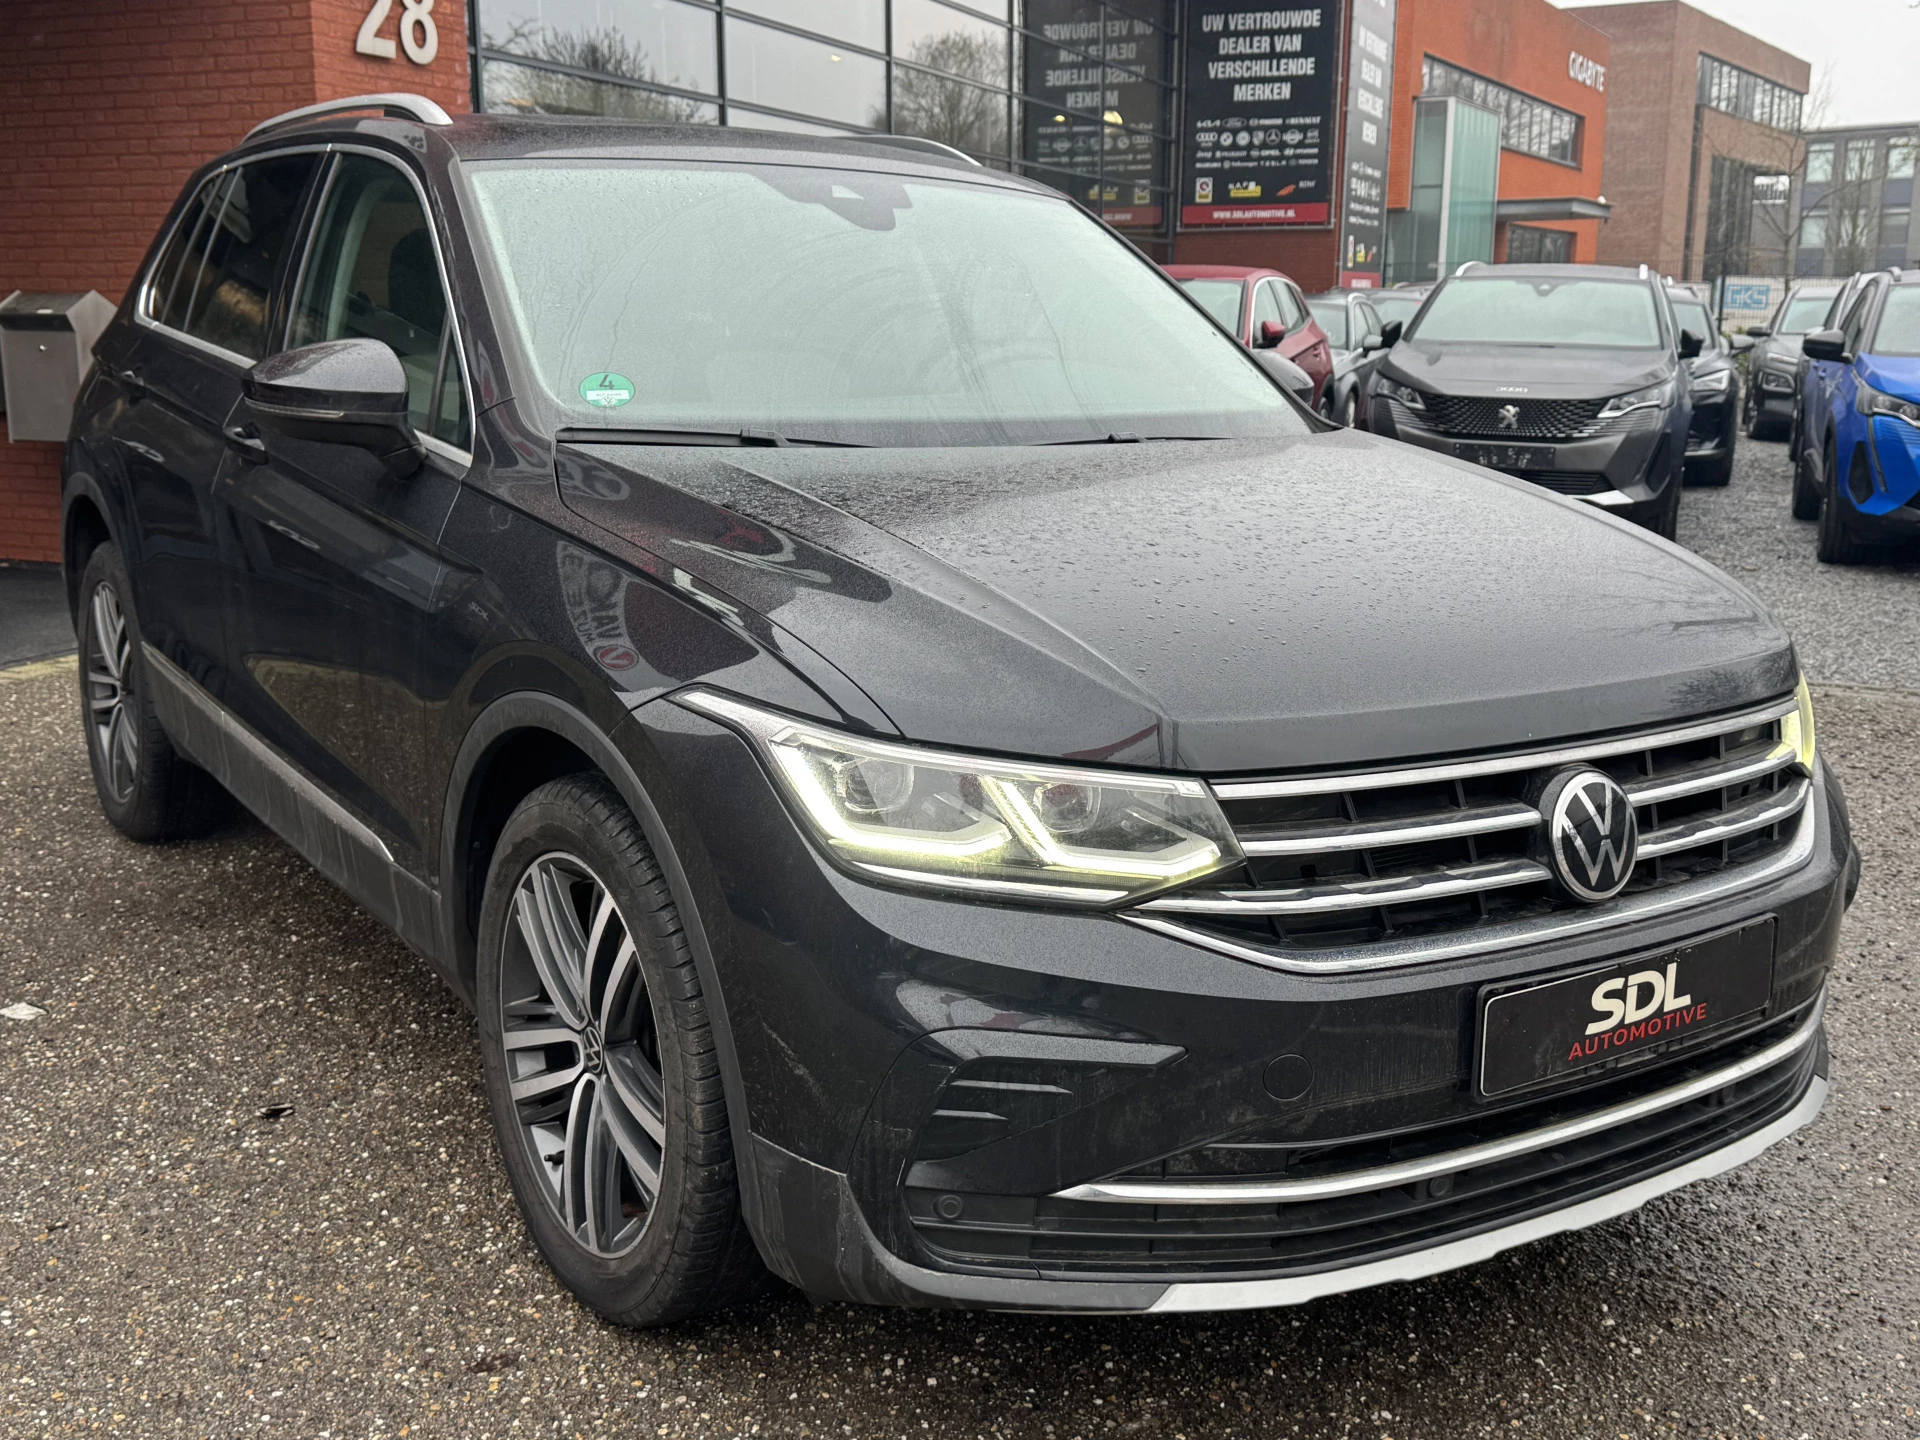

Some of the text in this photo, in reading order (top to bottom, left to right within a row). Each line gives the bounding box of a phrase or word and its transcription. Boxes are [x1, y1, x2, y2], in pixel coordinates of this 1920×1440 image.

[1202, 9, 1321, 32] UW VERTROUWDE
[356, 0, 438, 65] 28
[1219, 34, 1302, 55] DEALER VAN
[1208, 57, 1316, 79] VERSCHILLENDE
[1233, 82, 1291, 102] MERKEN
[599, 373, 615, 390] 4
[1584, 961, 1692, 1036] SDL
[1568, 1002, 1708, 1061] AUTOMOTIVE
